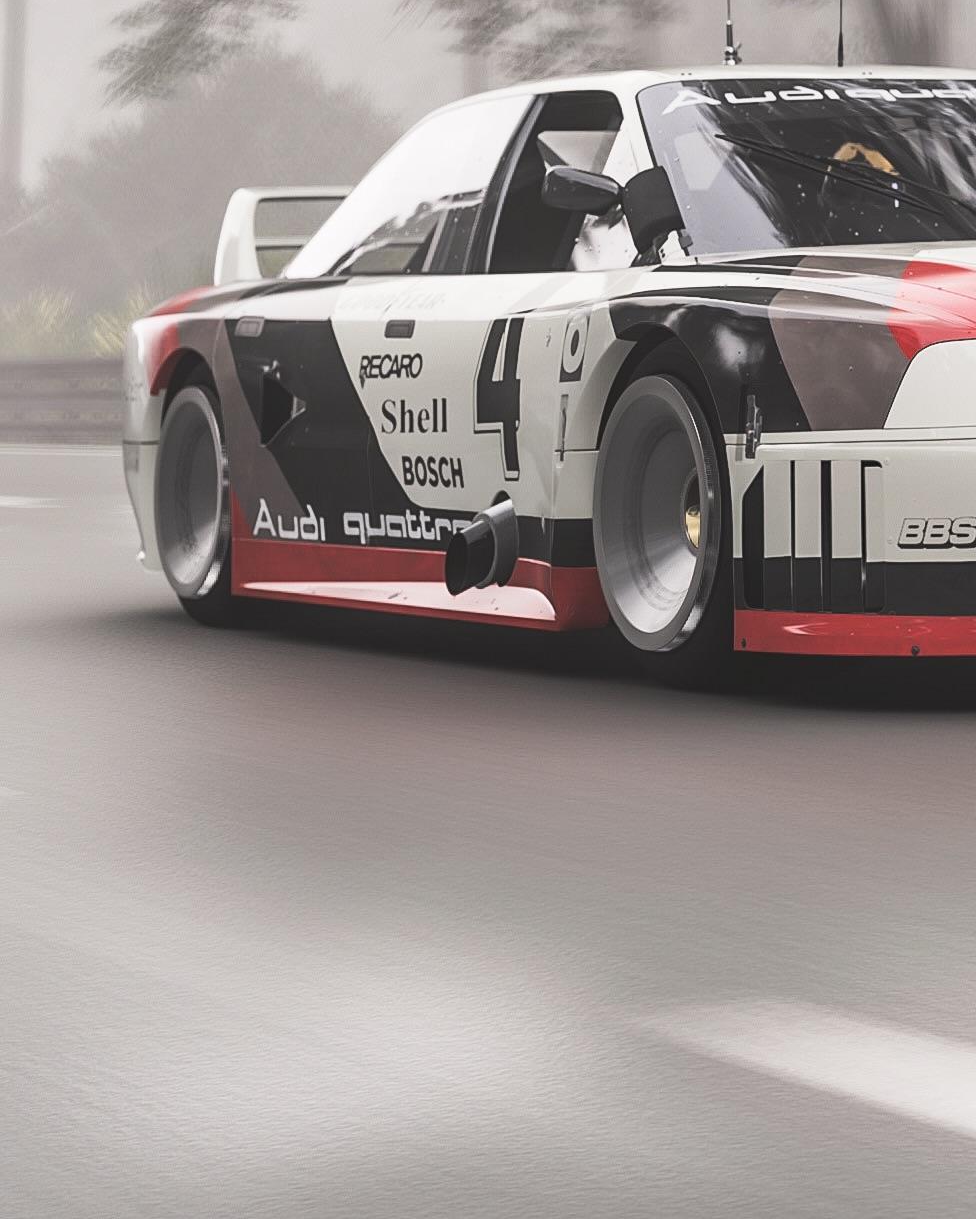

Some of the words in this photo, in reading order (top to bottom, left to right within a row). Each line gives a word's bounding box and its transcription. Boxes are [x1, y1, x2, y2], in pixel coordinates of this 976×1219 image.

[359, 353, 423, 379] RECARO
[381, 397, 448, 434] Shell
[473, 317, 525, 481] 4
[401, 455, 465, 489] BOSCH
[253, 498, 326, 541] Audi
